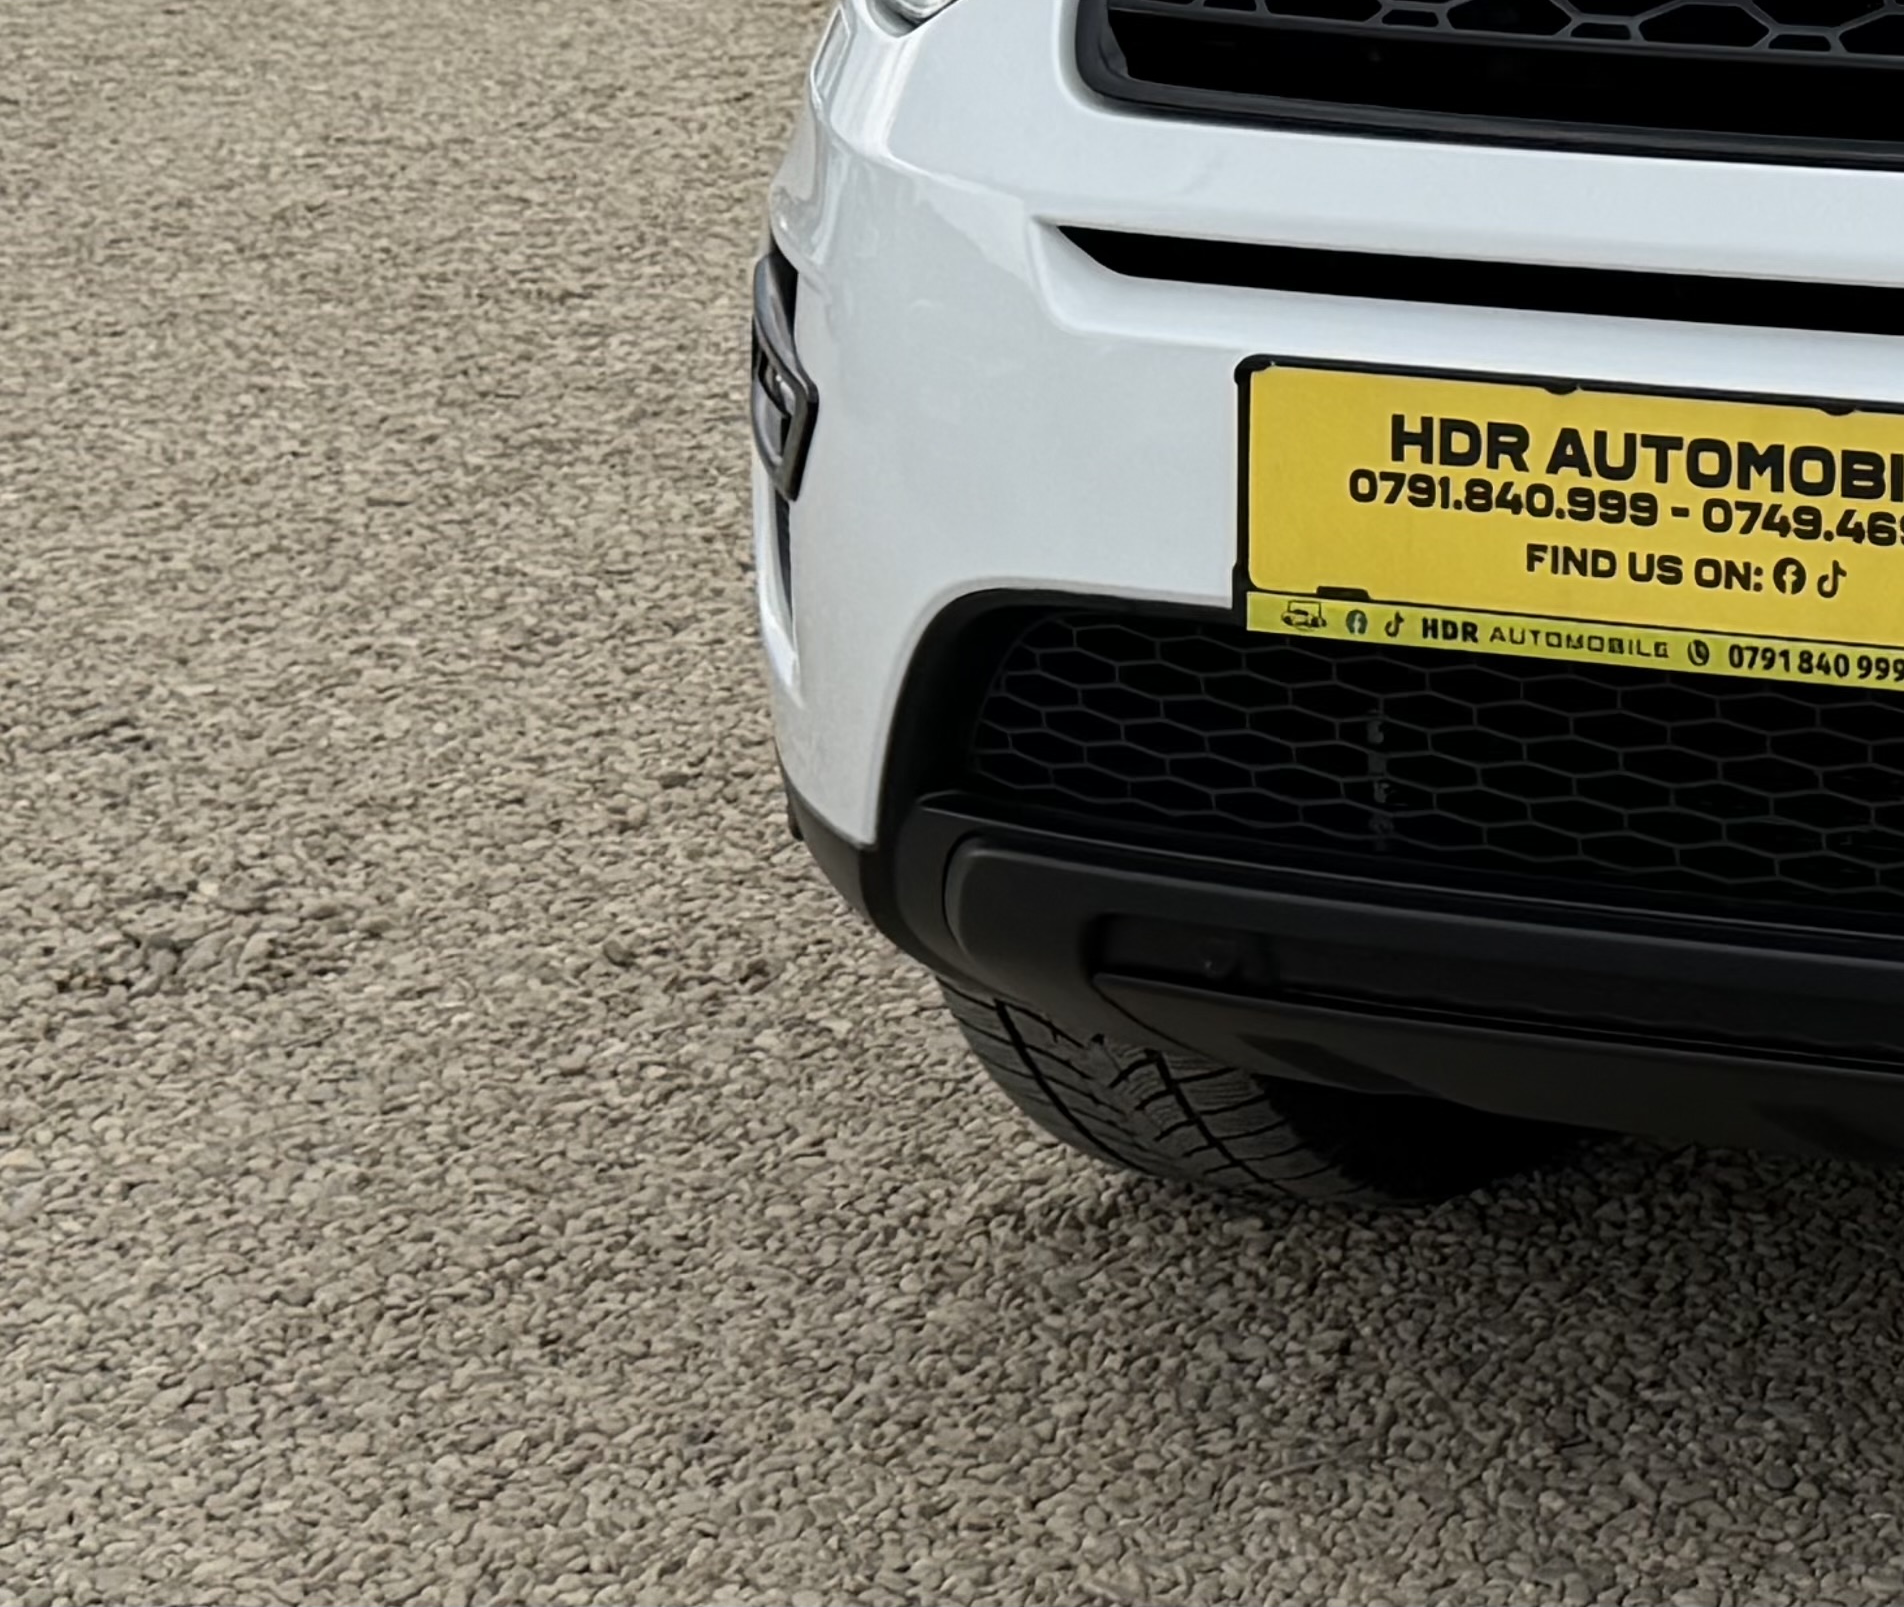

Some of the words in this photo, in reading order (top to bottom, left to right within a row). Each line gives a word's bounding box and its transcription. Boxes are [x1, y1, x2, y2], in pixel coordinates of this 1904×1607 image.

[1390, 412, 1531, 473] HDR
[1349, 468, 1659, 527] 0791.840.999
[1525, 542, 1618, 579] FIND
[1627, 550, 1684, 586] US
[1693, 557, 1764, 593] ON:
[1420, 615, 1480, 644] HDR
[1488, 625, 1670, 660] AUTOMOBILE
[1728, 643, 1792, 675] 0791
[1798, 647, 1851, 679] 840
